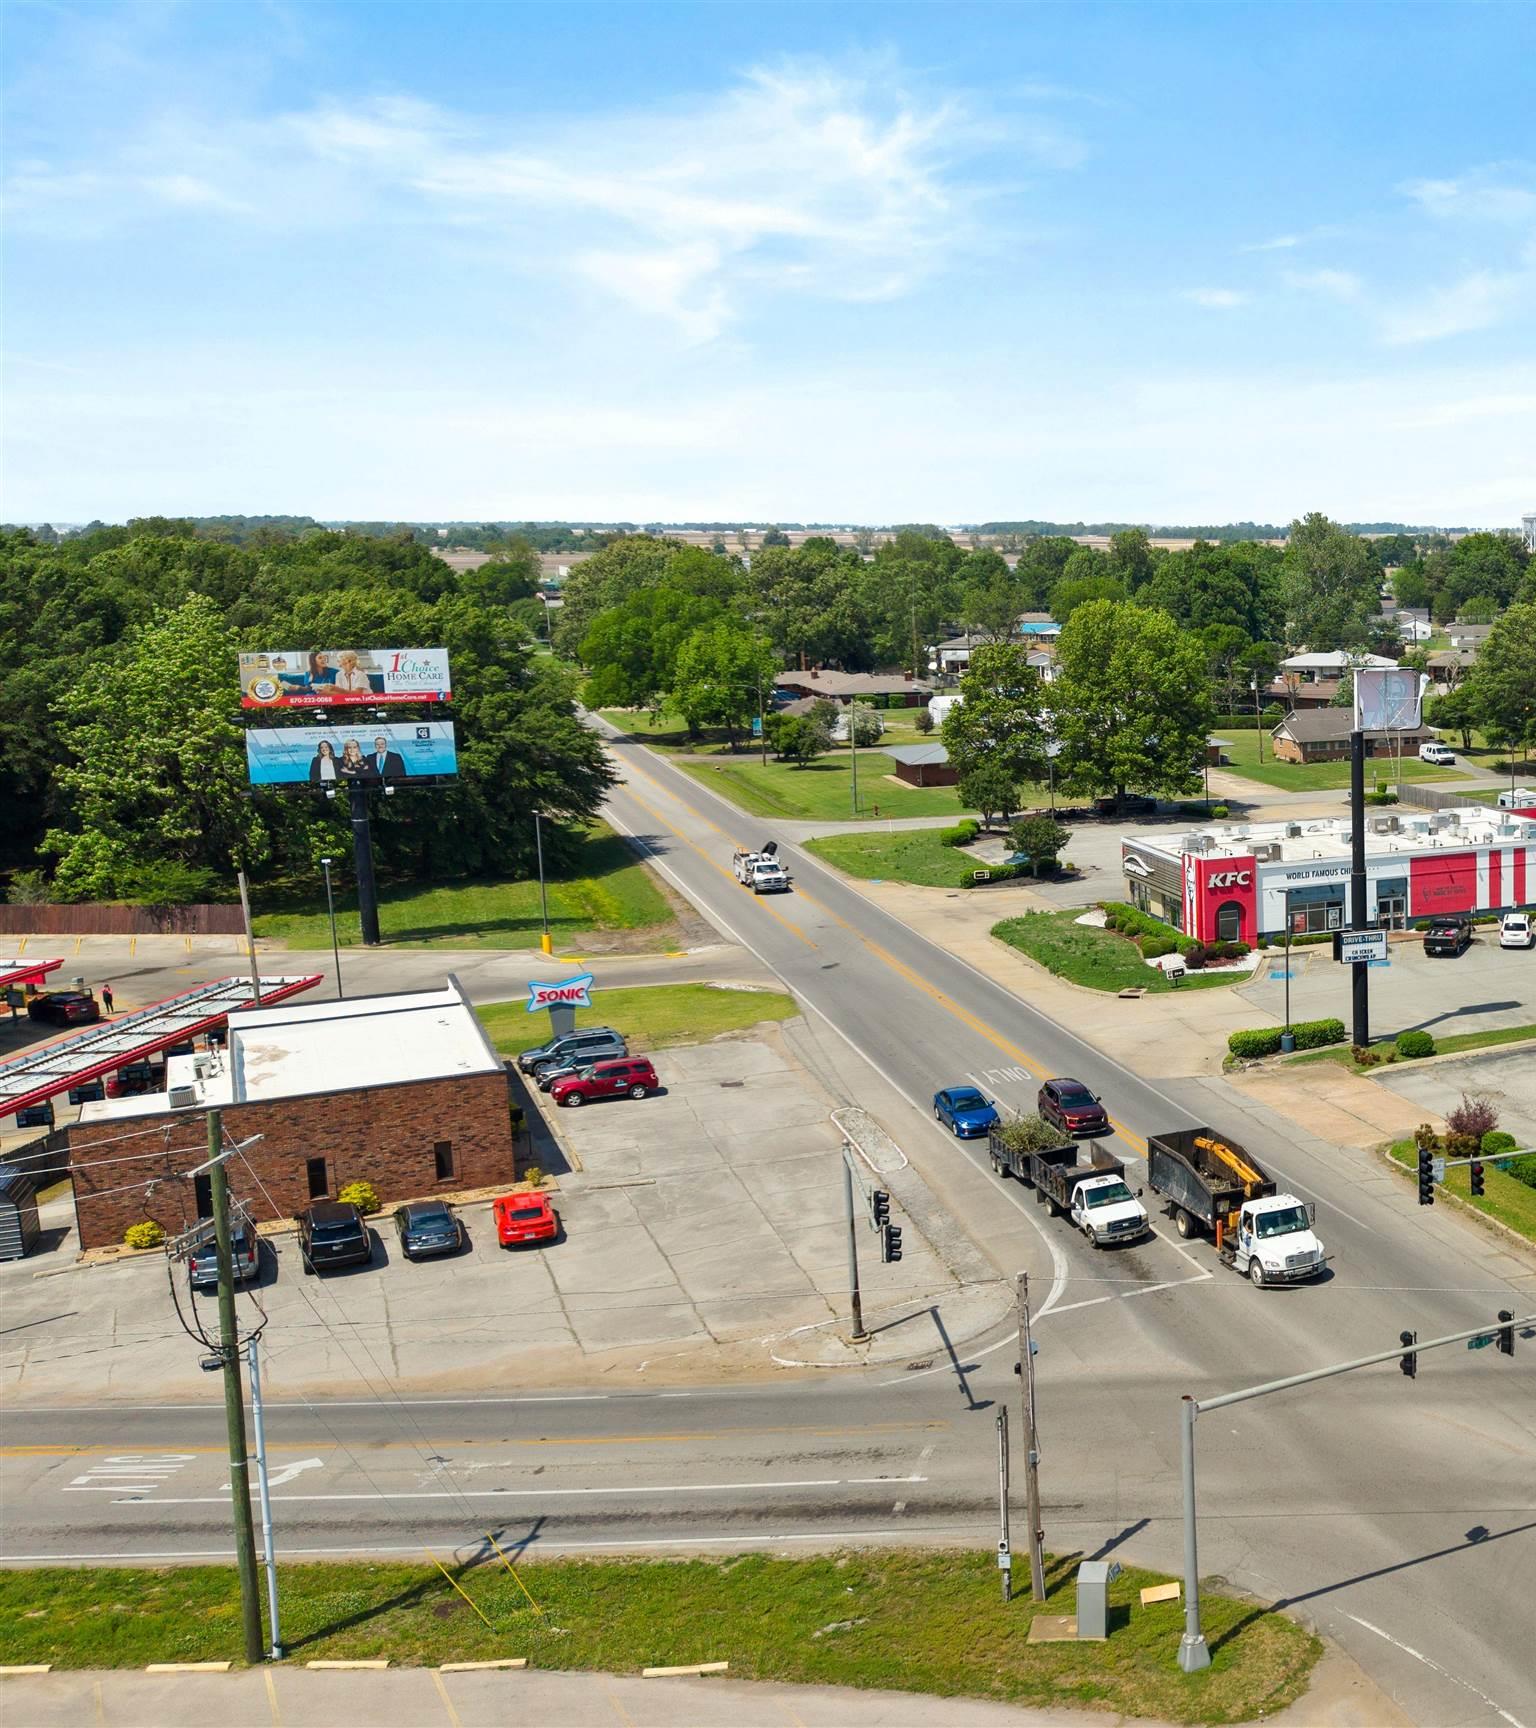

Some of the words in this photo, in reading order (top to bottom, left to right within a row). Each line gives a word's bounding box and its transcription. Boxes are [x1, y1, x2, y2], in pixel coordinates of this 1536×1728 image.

[401, 660, 440, 674] Choice
[387, 673, 416, 681] HOME
[418, 672, 444, 680] CARE
[1207, 870, 1251, 889] KFC
[1286, 871, 1310, 880] WORLD
[1311, 868, 1339, 879] FAMOUS
[1343, 934, 1382, 944] DRIVE-THRU
[536, 987, 585, 1003] SONIC
[982, 1067, 1032, 1084] ONLY
[61, 1454, 197, 1493] ONLY
